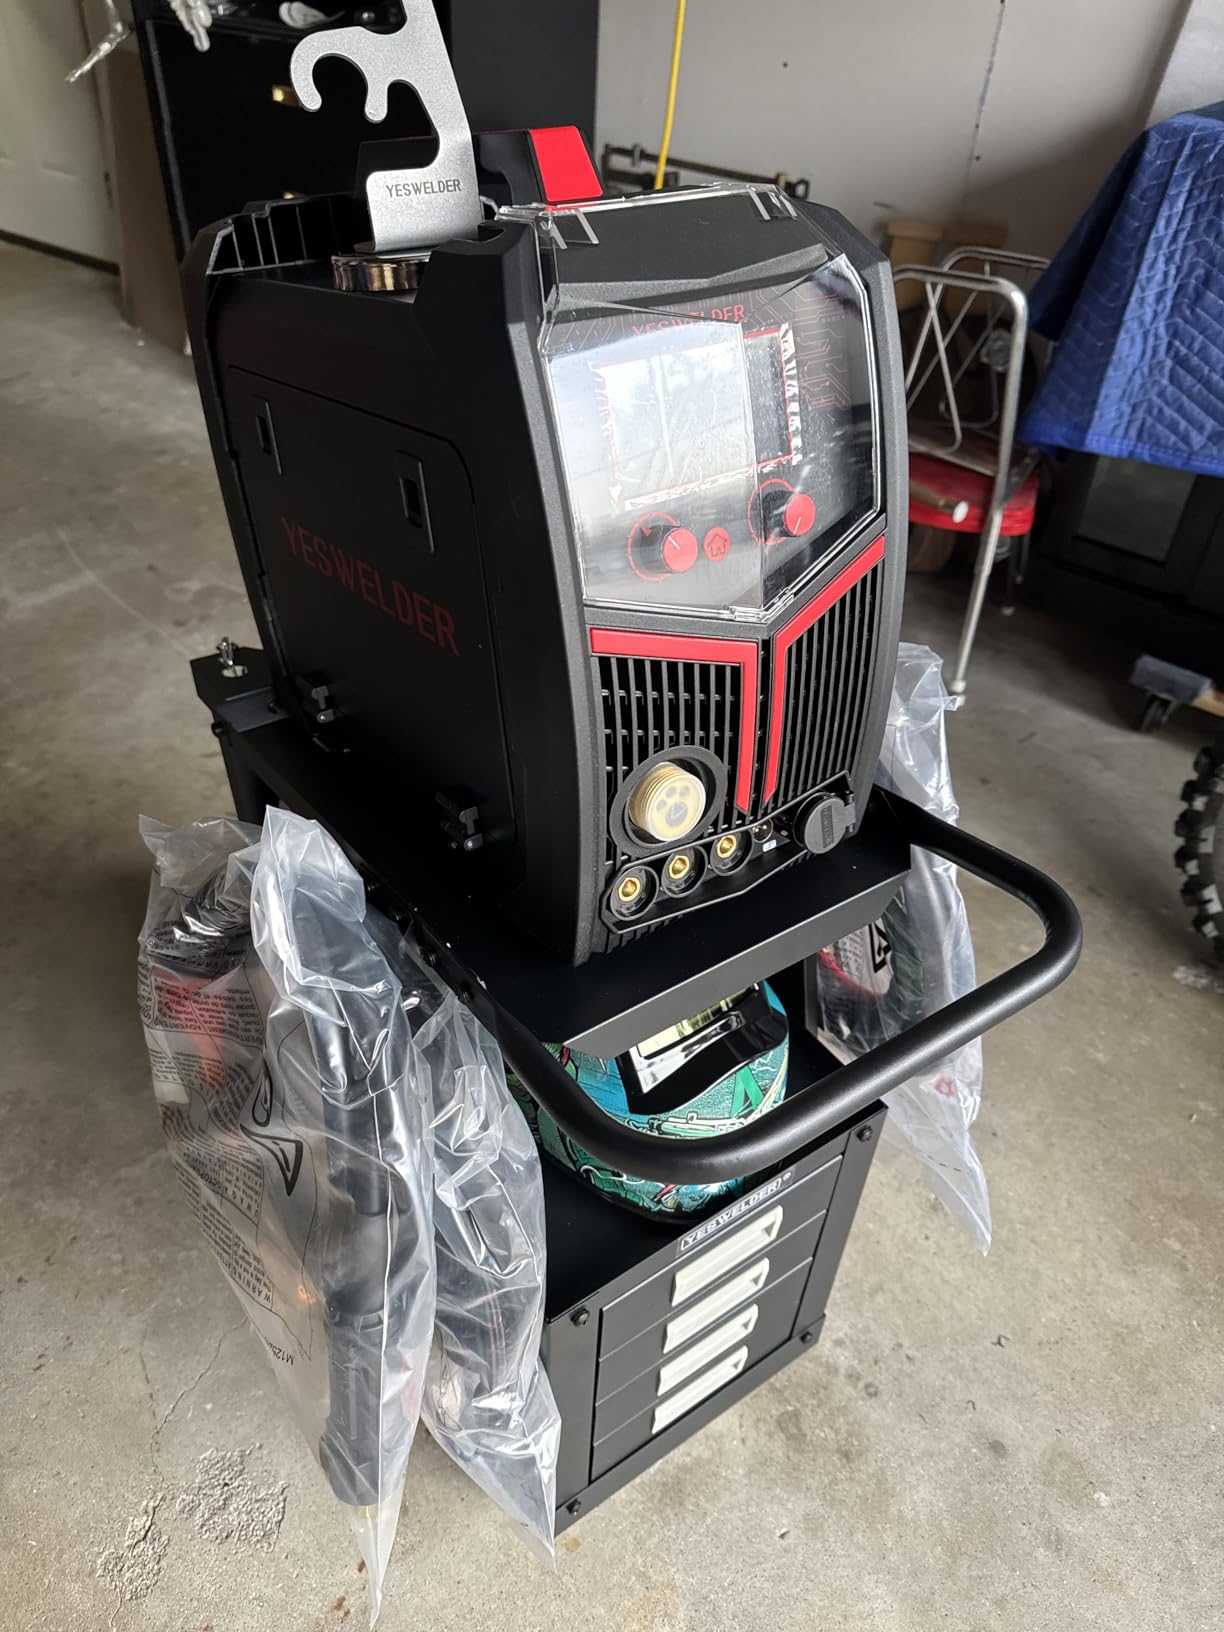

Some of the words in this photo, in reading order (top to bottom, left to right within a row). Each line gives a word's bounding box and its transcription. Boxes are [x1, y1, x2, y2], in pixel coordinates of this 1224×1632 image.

[385, 179, 461, 197] YESWELDER
[280, 516, 460, 656] YESWELDER
[685, 1180, 778, 1245] YESWELDER
